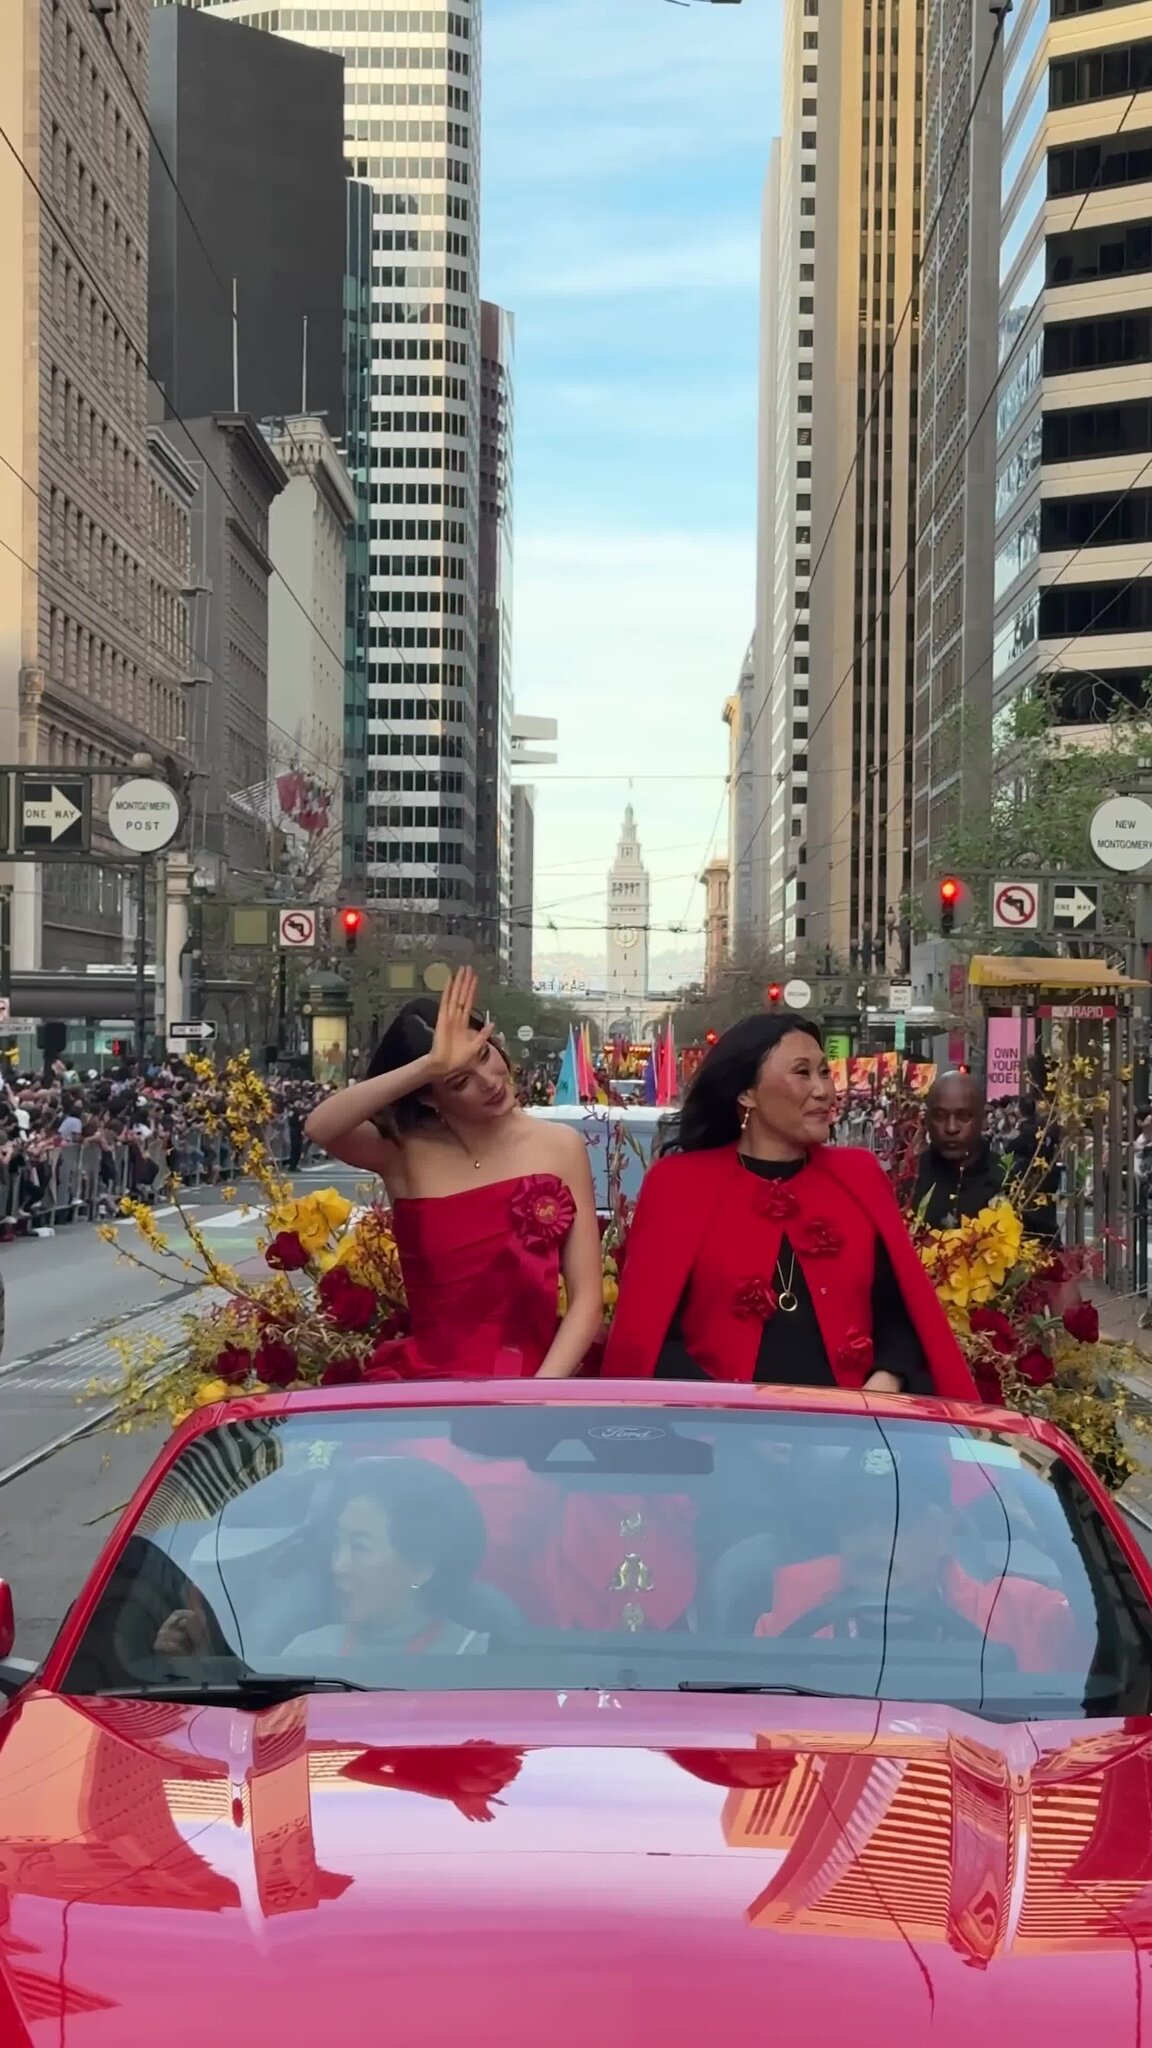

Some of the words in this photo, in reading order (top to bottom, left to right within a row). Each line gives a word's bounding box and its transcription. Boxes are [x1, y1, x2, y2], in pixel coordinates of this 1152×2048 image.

[115, 801, 171, 811] MONTGOMERY
[26, 809, 46, 819] ONE
[54, 809, 76, 819] WAY
[126, 821, 160, 831] POST
[1115, 820, 1137, 830] NEW
[1073, 1006, 1104, 1018] RAPID
[994, 1047, 1019, 1059] OWN
[601, 1426, 652, 1439] Ford
